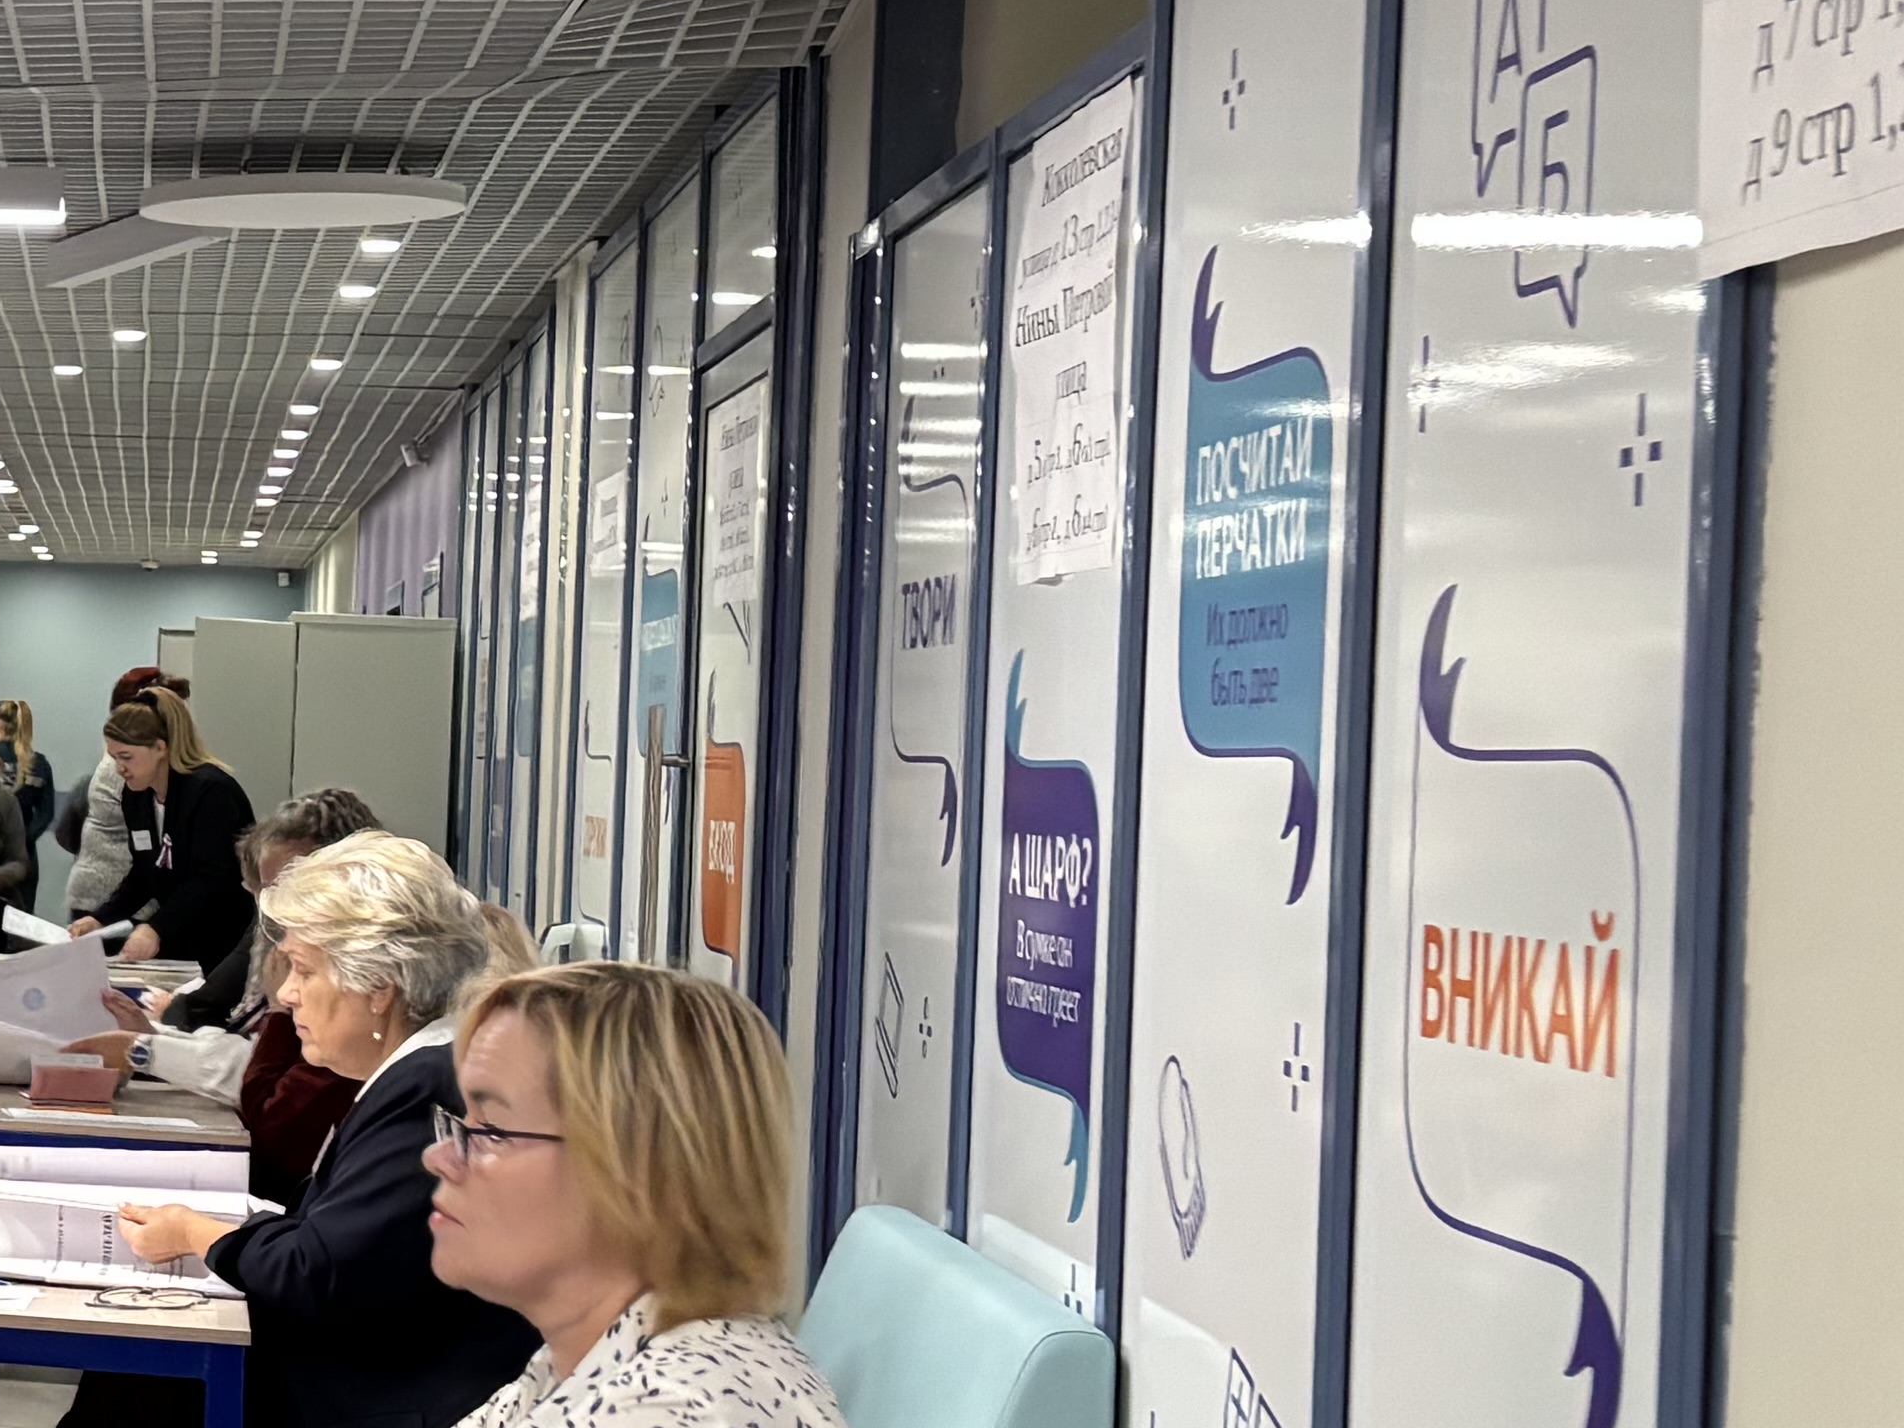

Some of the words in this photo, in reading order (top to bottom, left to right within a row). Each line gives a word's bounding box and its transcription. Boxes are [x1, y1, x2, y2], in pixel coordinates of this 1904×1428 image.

[1770, 108, 1792, 178] 9
[1798, 102, 1856, 178] стр
[1870, 60, 1904, 152] 1,
[1015, 302, 1060, 348] Нины
[1195, 497, 1308, 580] ПЕРЧАТКИ
[900, 572, 956, 650] ТВОРИ
[1008, 832, 1022, 897] А
[1025, 832, 1093, 909] ШАРФ?
[1421, 909, 1620, 1079] ВНИКАЙ
